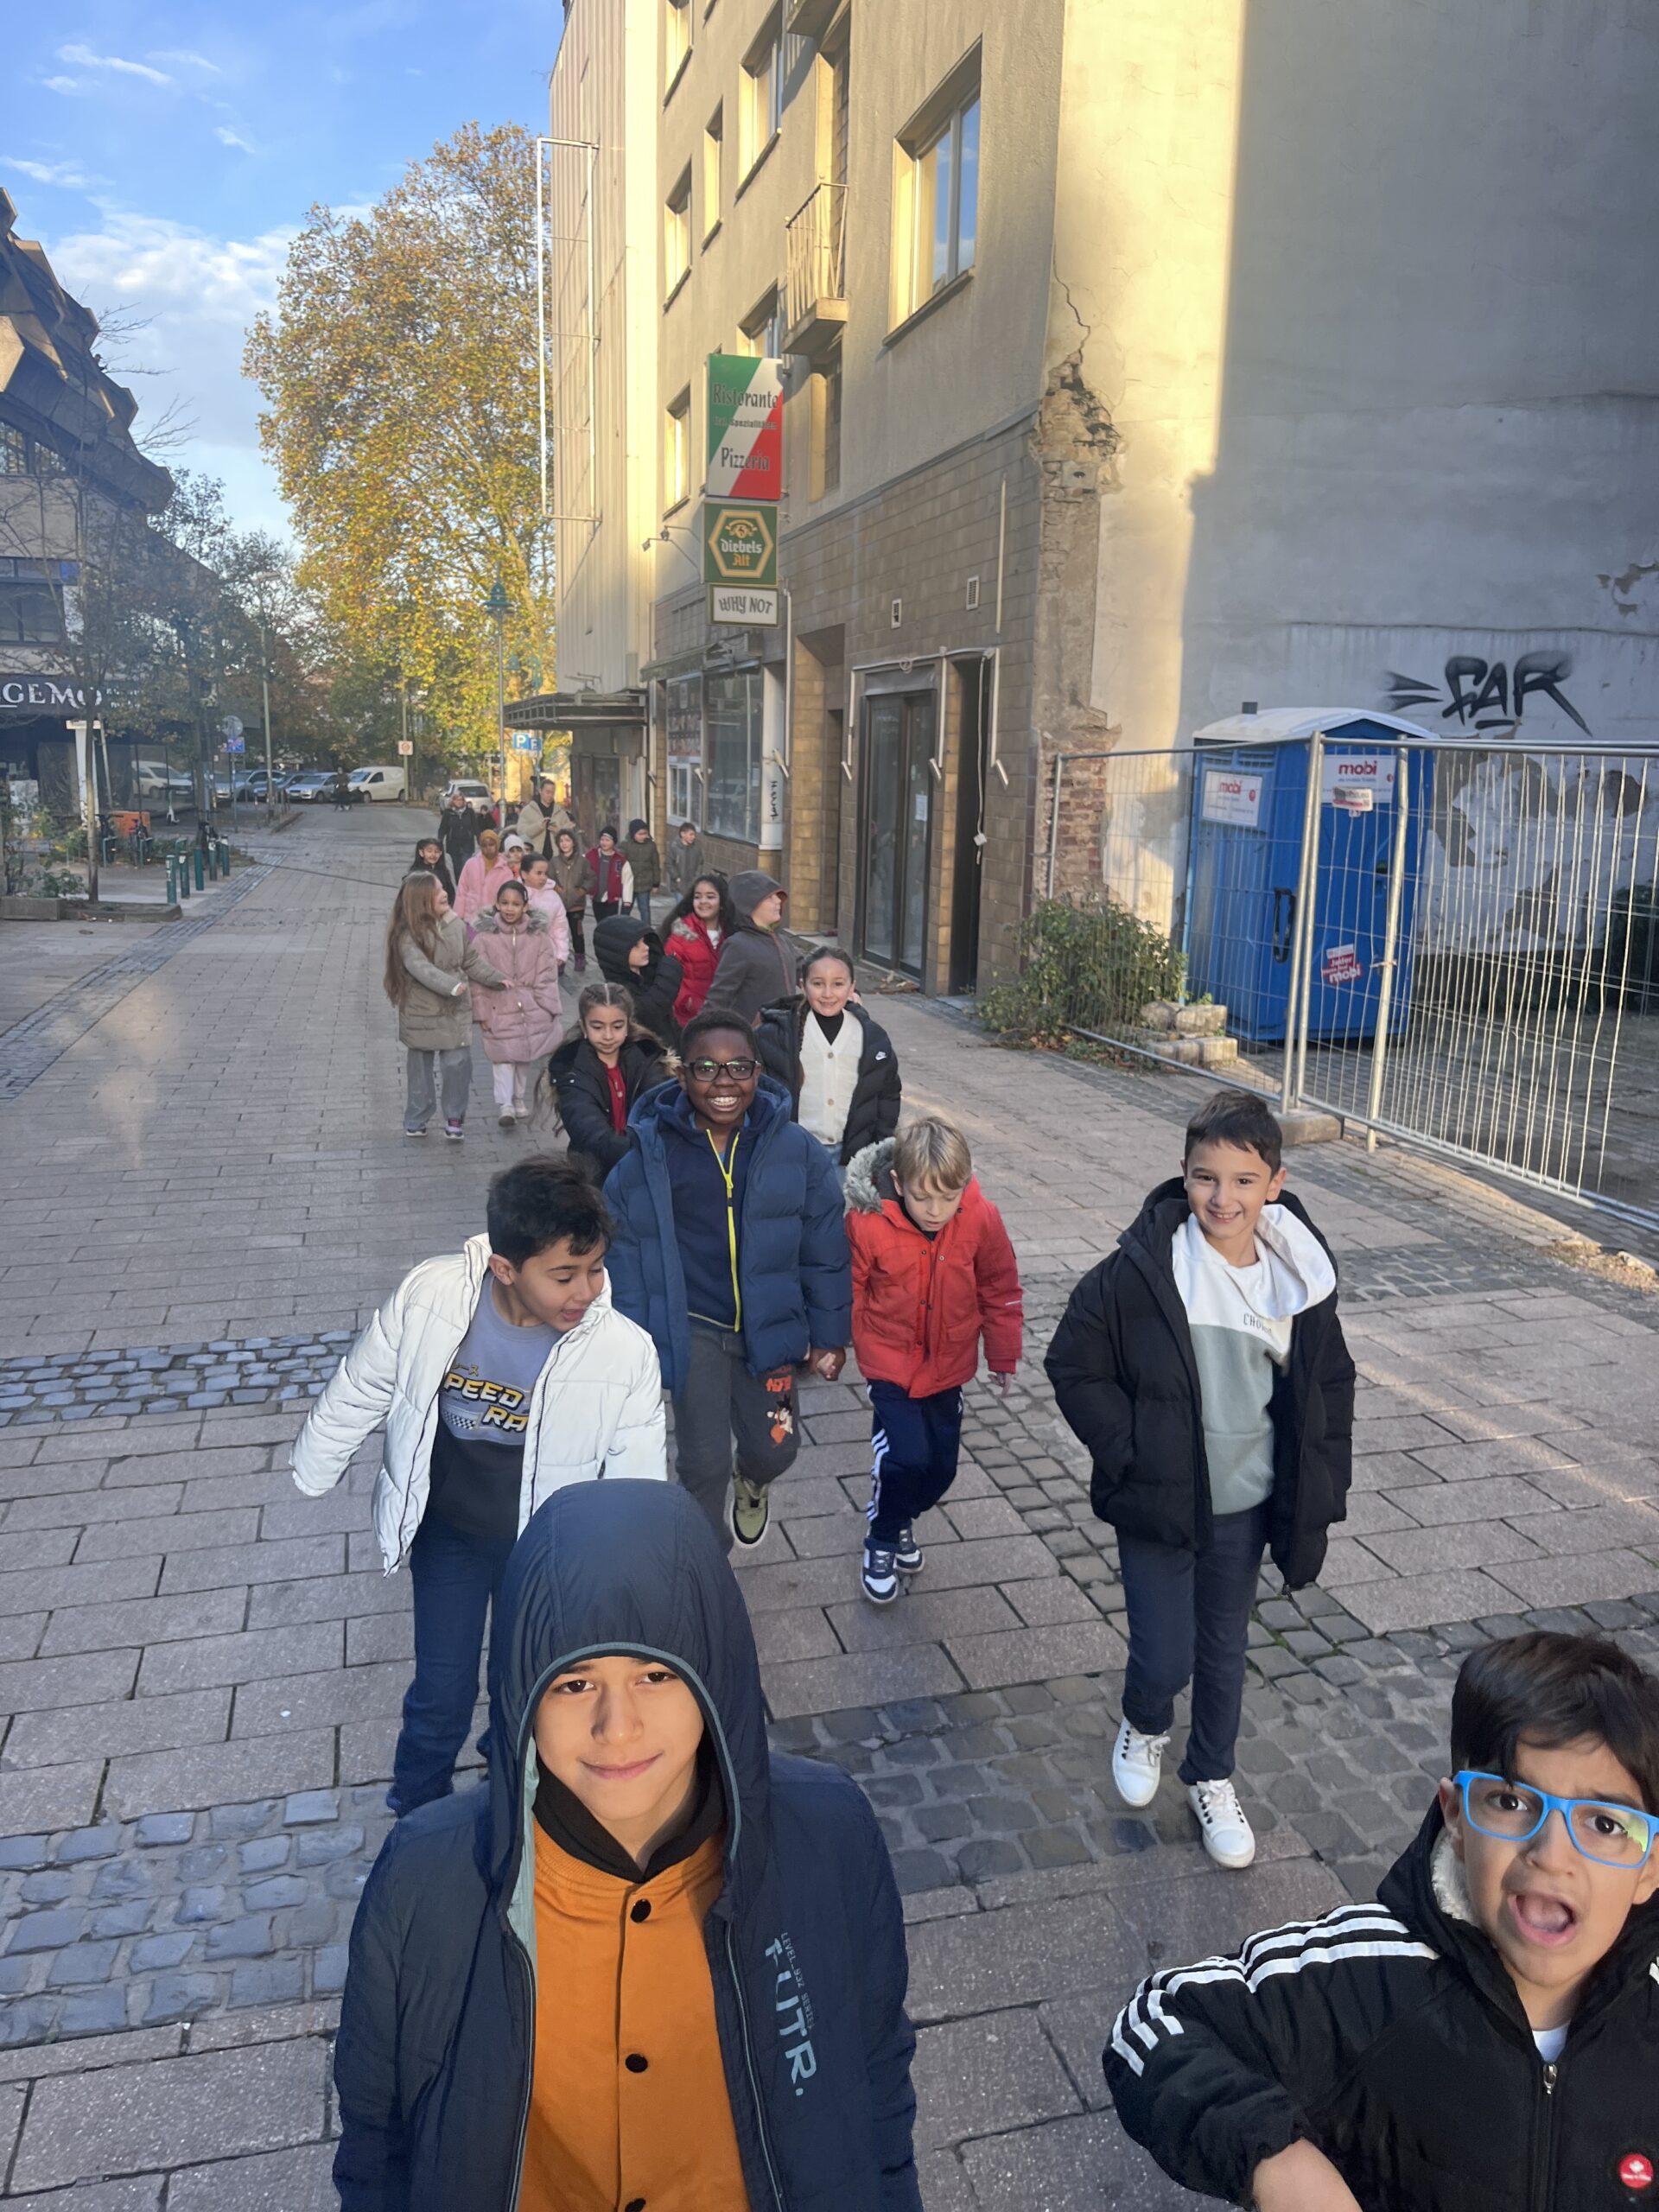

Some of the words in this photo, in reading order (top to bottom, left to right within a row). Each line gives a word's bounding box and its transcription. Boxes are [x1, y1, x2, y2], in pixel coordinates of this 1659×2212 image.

[714, 384, 779, 409] Ristorante
[721, 447, 770, 471] Pizzeria
[719, 595, 747, 614] WHY
[749, 597, 773, 614] NOT
[516, 734, 526, 747] P
[1338, 760, 1378, 775] mobi
[1220, 780, 1243, 794] mobi
[1329, 963, 1360, 983] mobi
